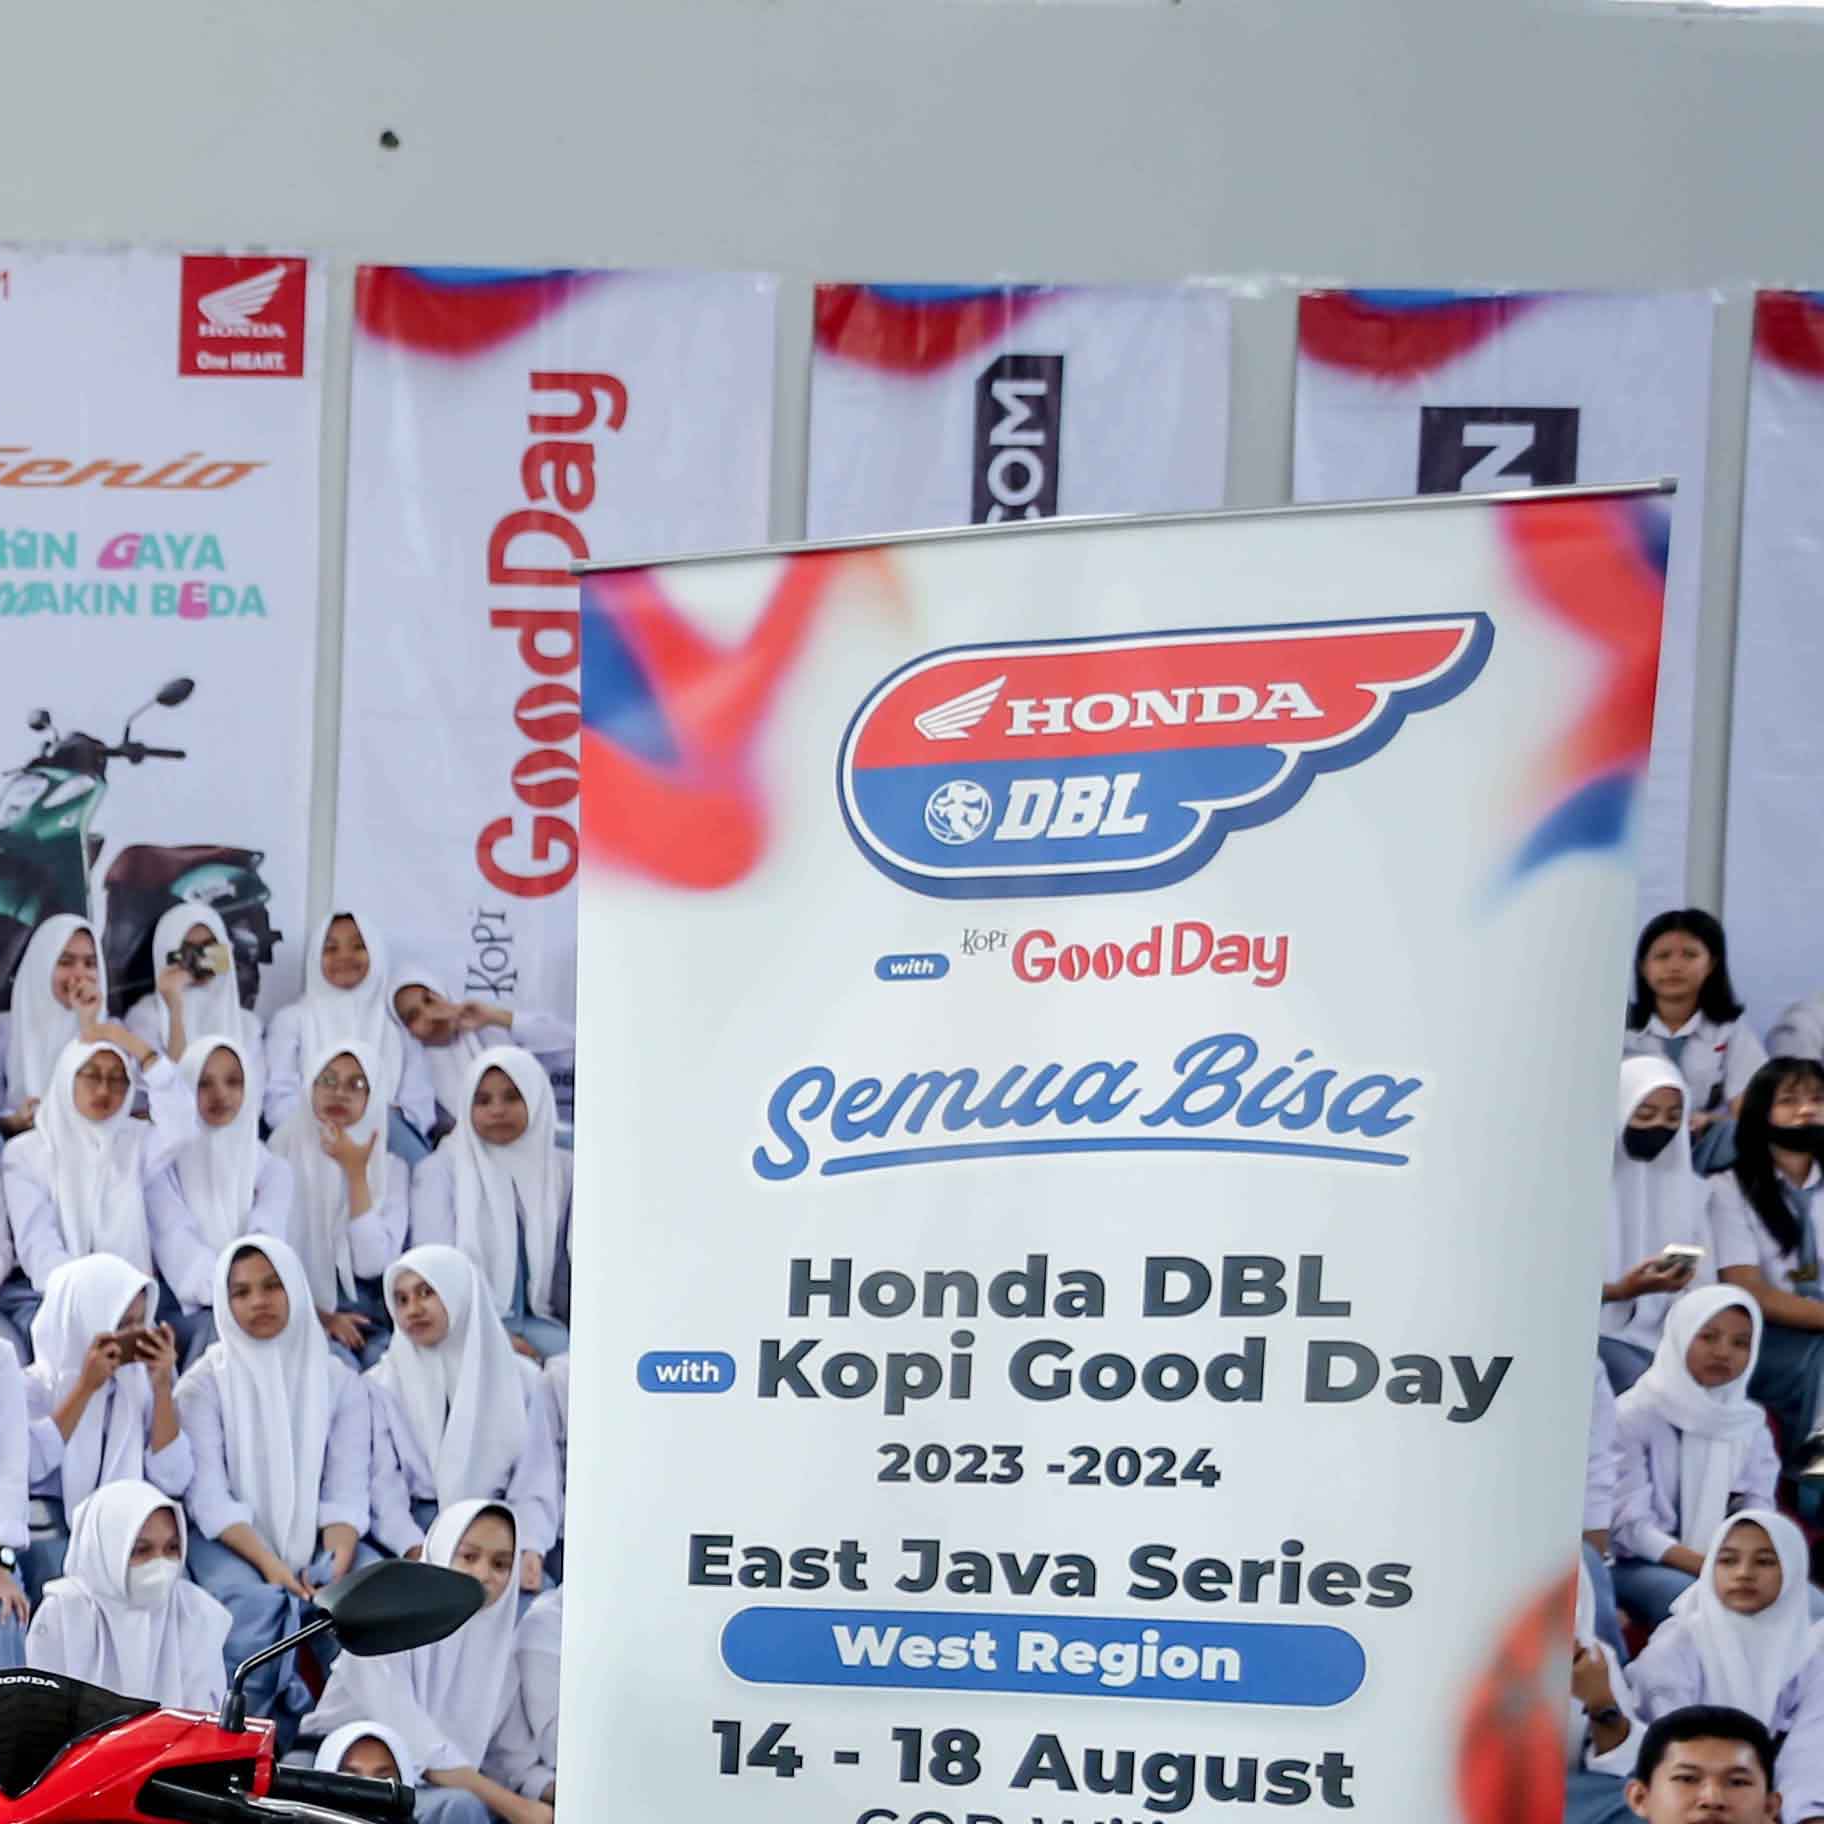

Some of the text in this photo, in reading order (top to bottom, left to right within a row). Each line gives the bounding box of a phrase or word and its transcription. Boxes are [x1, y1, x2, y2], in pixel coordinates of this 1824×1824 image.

[96, 532, 225, 570] GAYA
[149, 581, 267, 620] BEDA
[1004, 683, 1325, 737] HONDA
[993, 772, 1150, 841] DBL
[889, 957, 936, 977] with
[752, 1032, 1424, 1181] Semua Bisa
[787, 1253, 1353, 1319] Honda DBL
[654, 1329, 1513, 1424] with Kopi Good Day
[876, 1443, 1024, 1484] 2023
[688, 1533, 1414, 1607] East Java Series
[832, 1625, 1240, 1687] West Region
[712, 1719, 1356, 1814] 14 - 18 August
